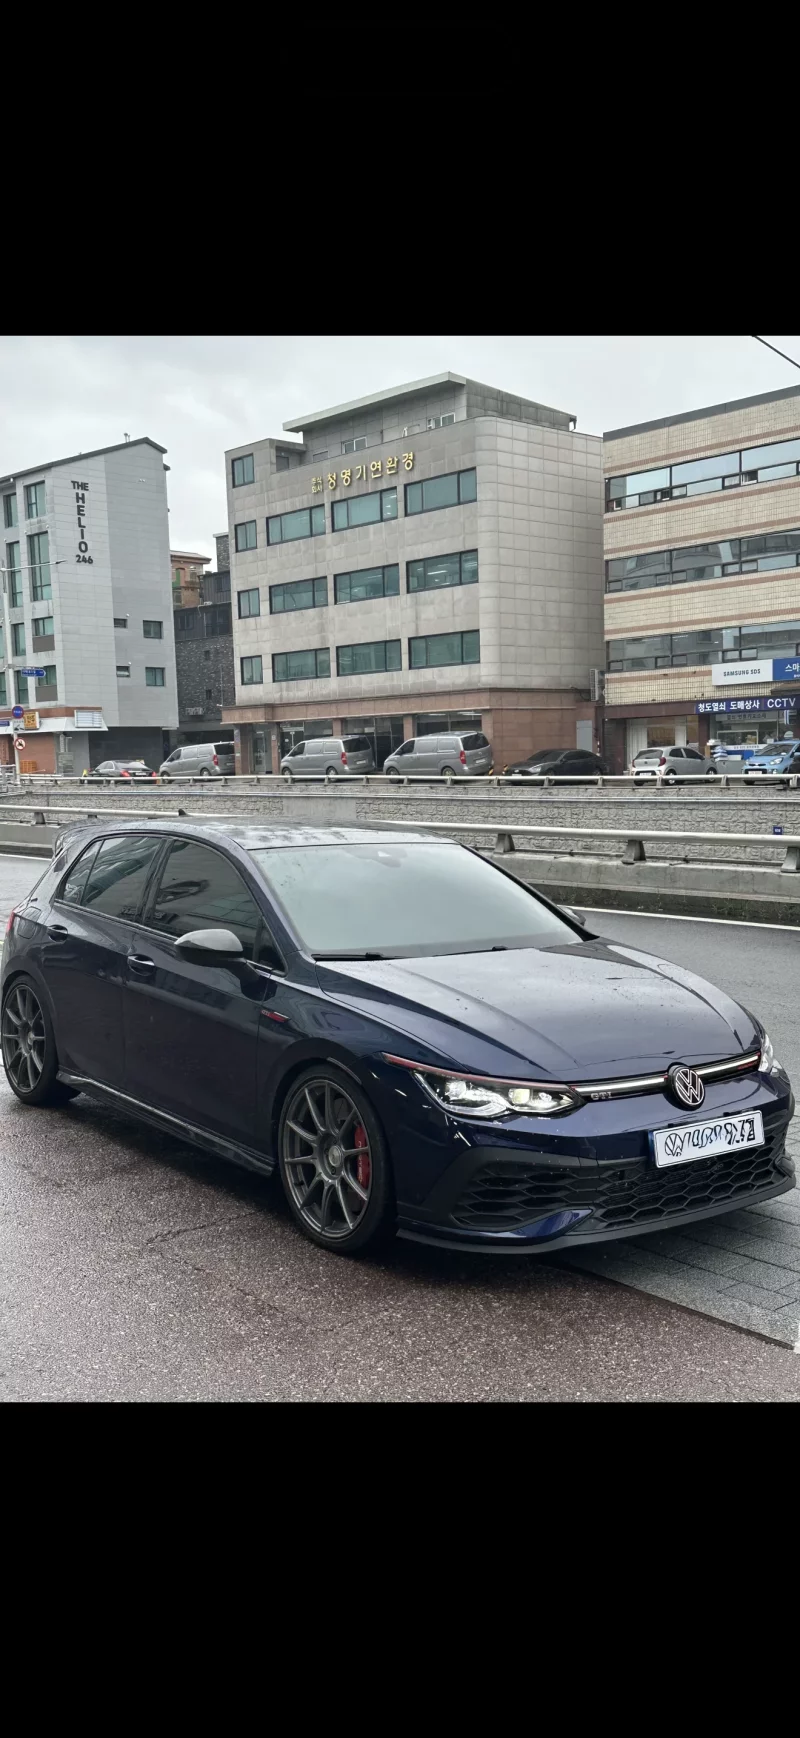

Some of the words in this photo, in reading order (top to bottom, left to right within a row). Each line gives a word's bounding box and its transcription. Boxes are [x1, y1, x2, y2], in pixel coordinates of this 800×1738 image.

[328, 452, 414, 490] 청명기연환경
[71, 480, 89, 491] THE
[76, 492, 88, 553] HELIO
[76, 554, 93, 564] 246
[723, 669, 749, 677] SAMSUNG
[698, 702, 726, 713] 청도열쇠
[730, 700, 760, 710] 도매상사
[767, 698, 796, 708] CCTV
[590, 1091, 612, 1101] GTI
